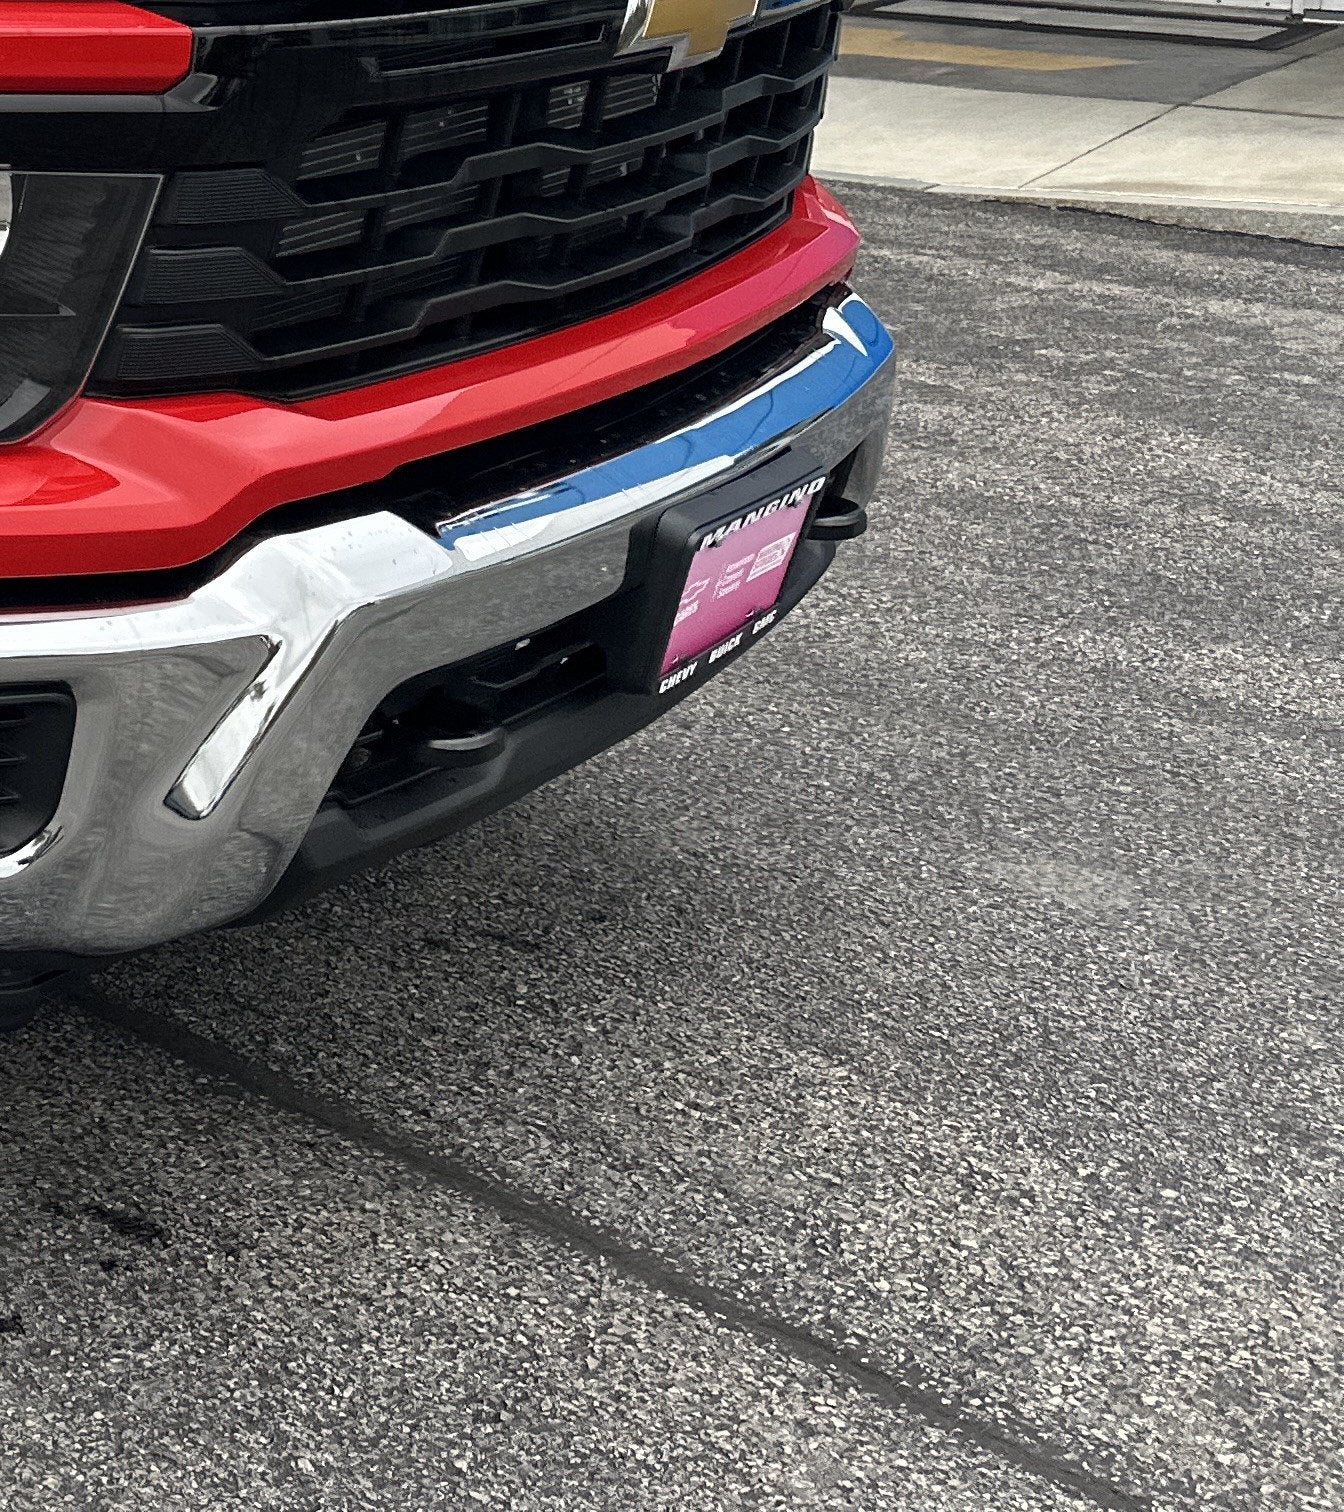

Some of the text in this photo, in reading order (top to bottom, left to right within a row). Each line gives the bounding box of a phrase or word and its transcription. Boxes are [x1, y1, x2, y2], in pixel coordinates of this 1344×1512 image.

[698, 476, 827, 553] MANGINO
[658, 661, 699, 694] CHEVY
[708, 633, 743, 664] BUICK
